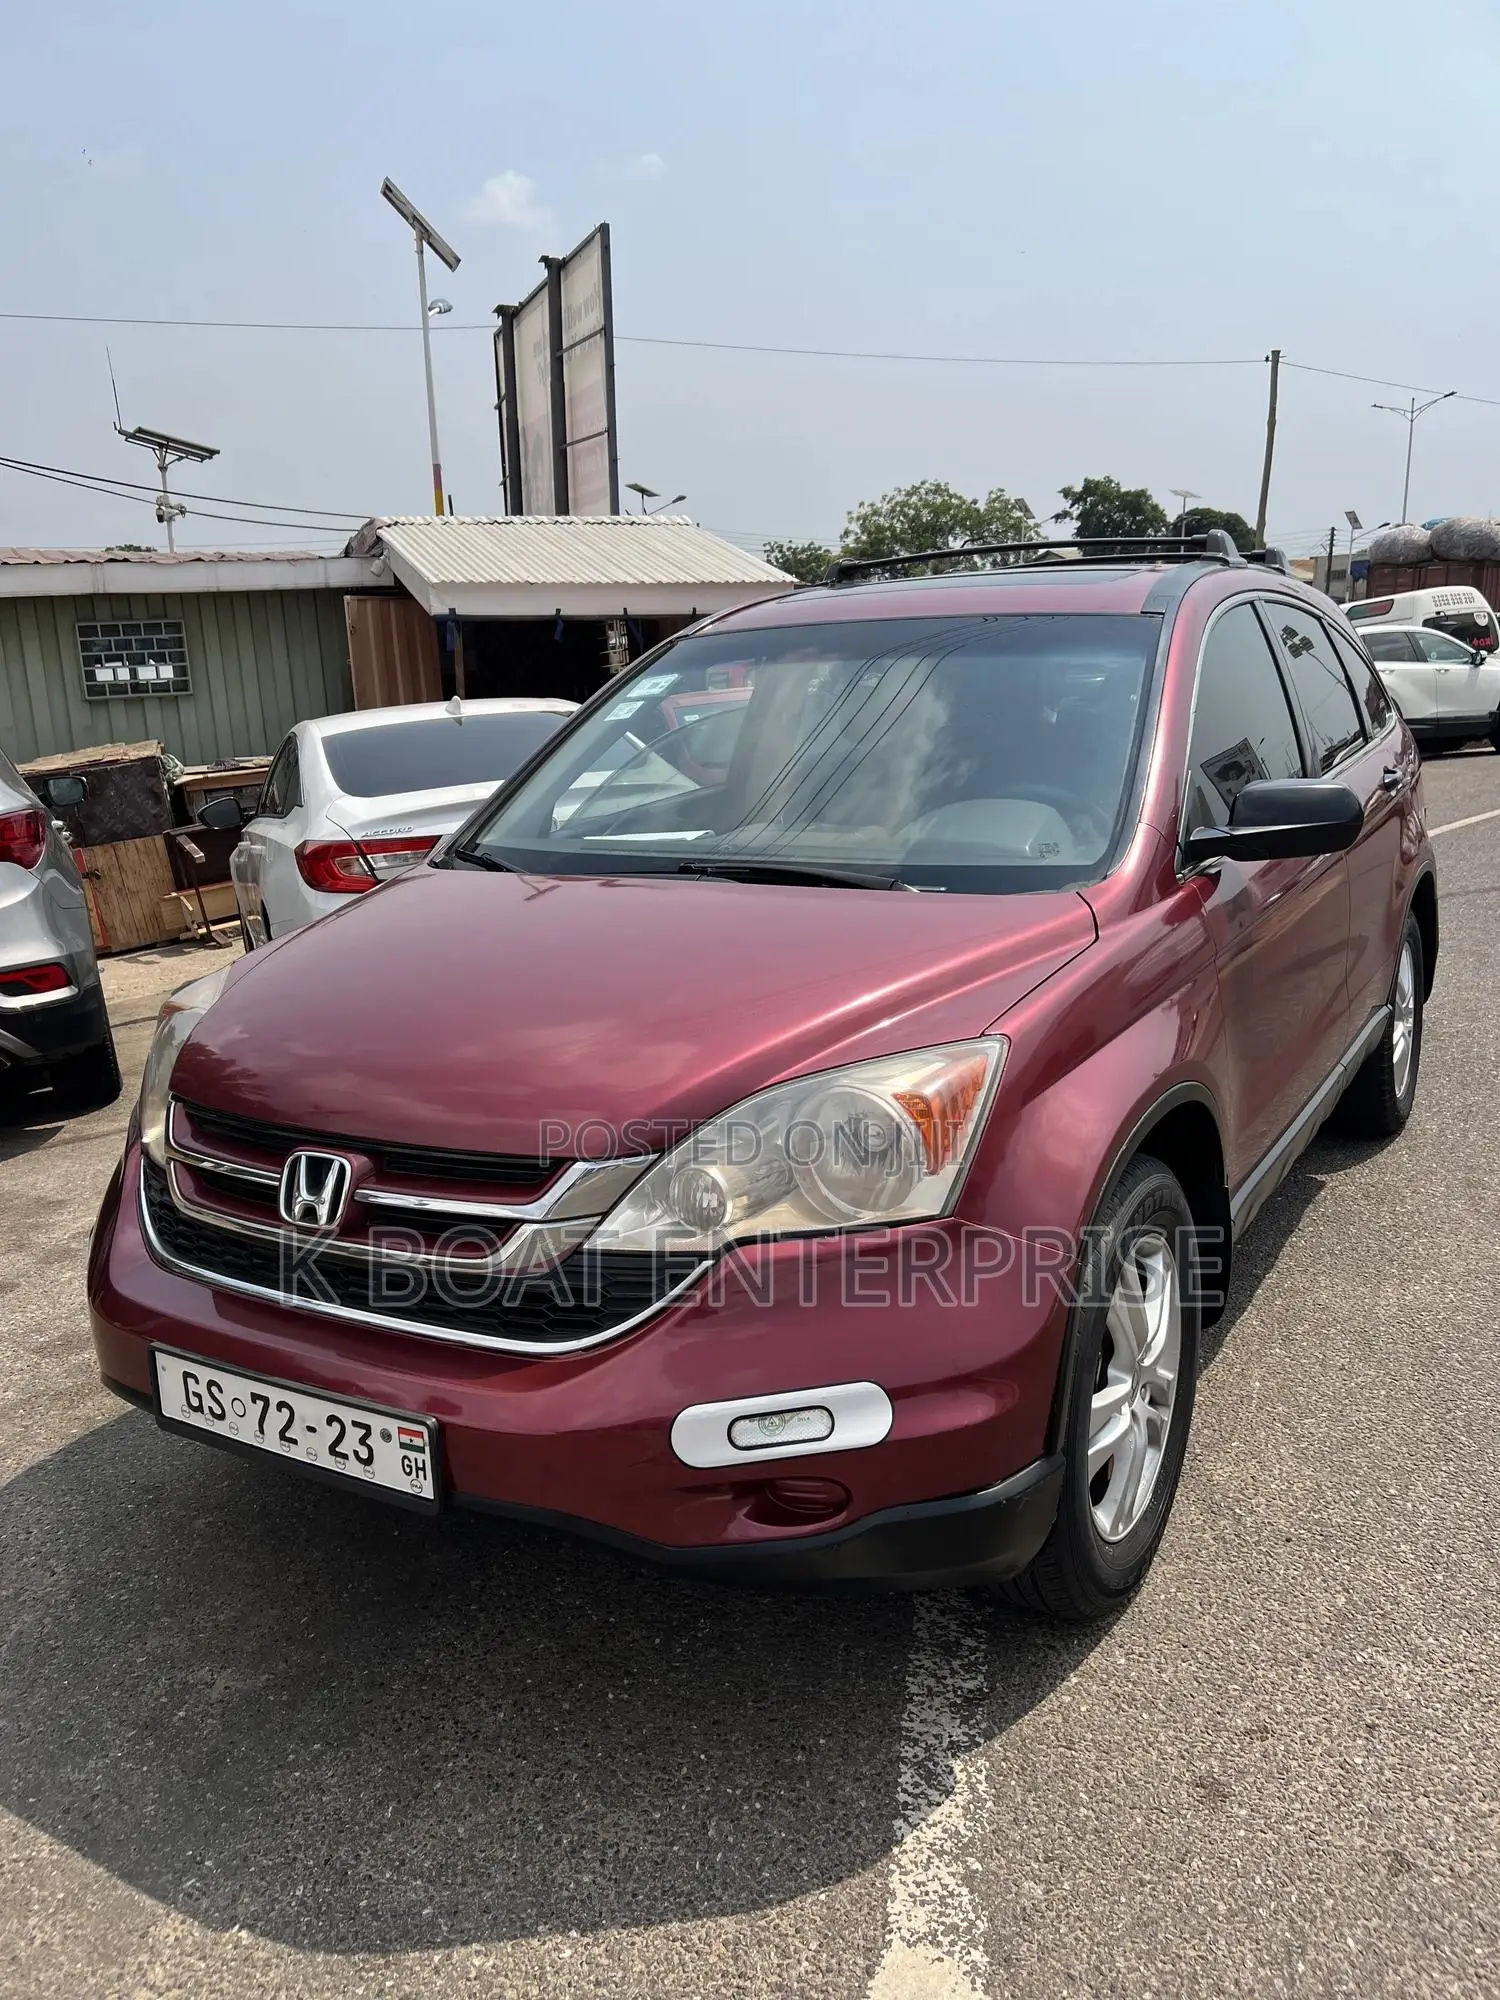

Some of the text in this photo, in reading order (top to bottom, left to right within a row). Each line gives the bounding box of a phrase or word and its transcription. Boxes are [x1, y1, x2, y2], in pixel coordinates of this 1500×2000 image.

[361, 825, 415, 838] ACCORD
[182, 1370, 375, 1466] GS 72-23
[401, 1454, 428, 1480] GH
